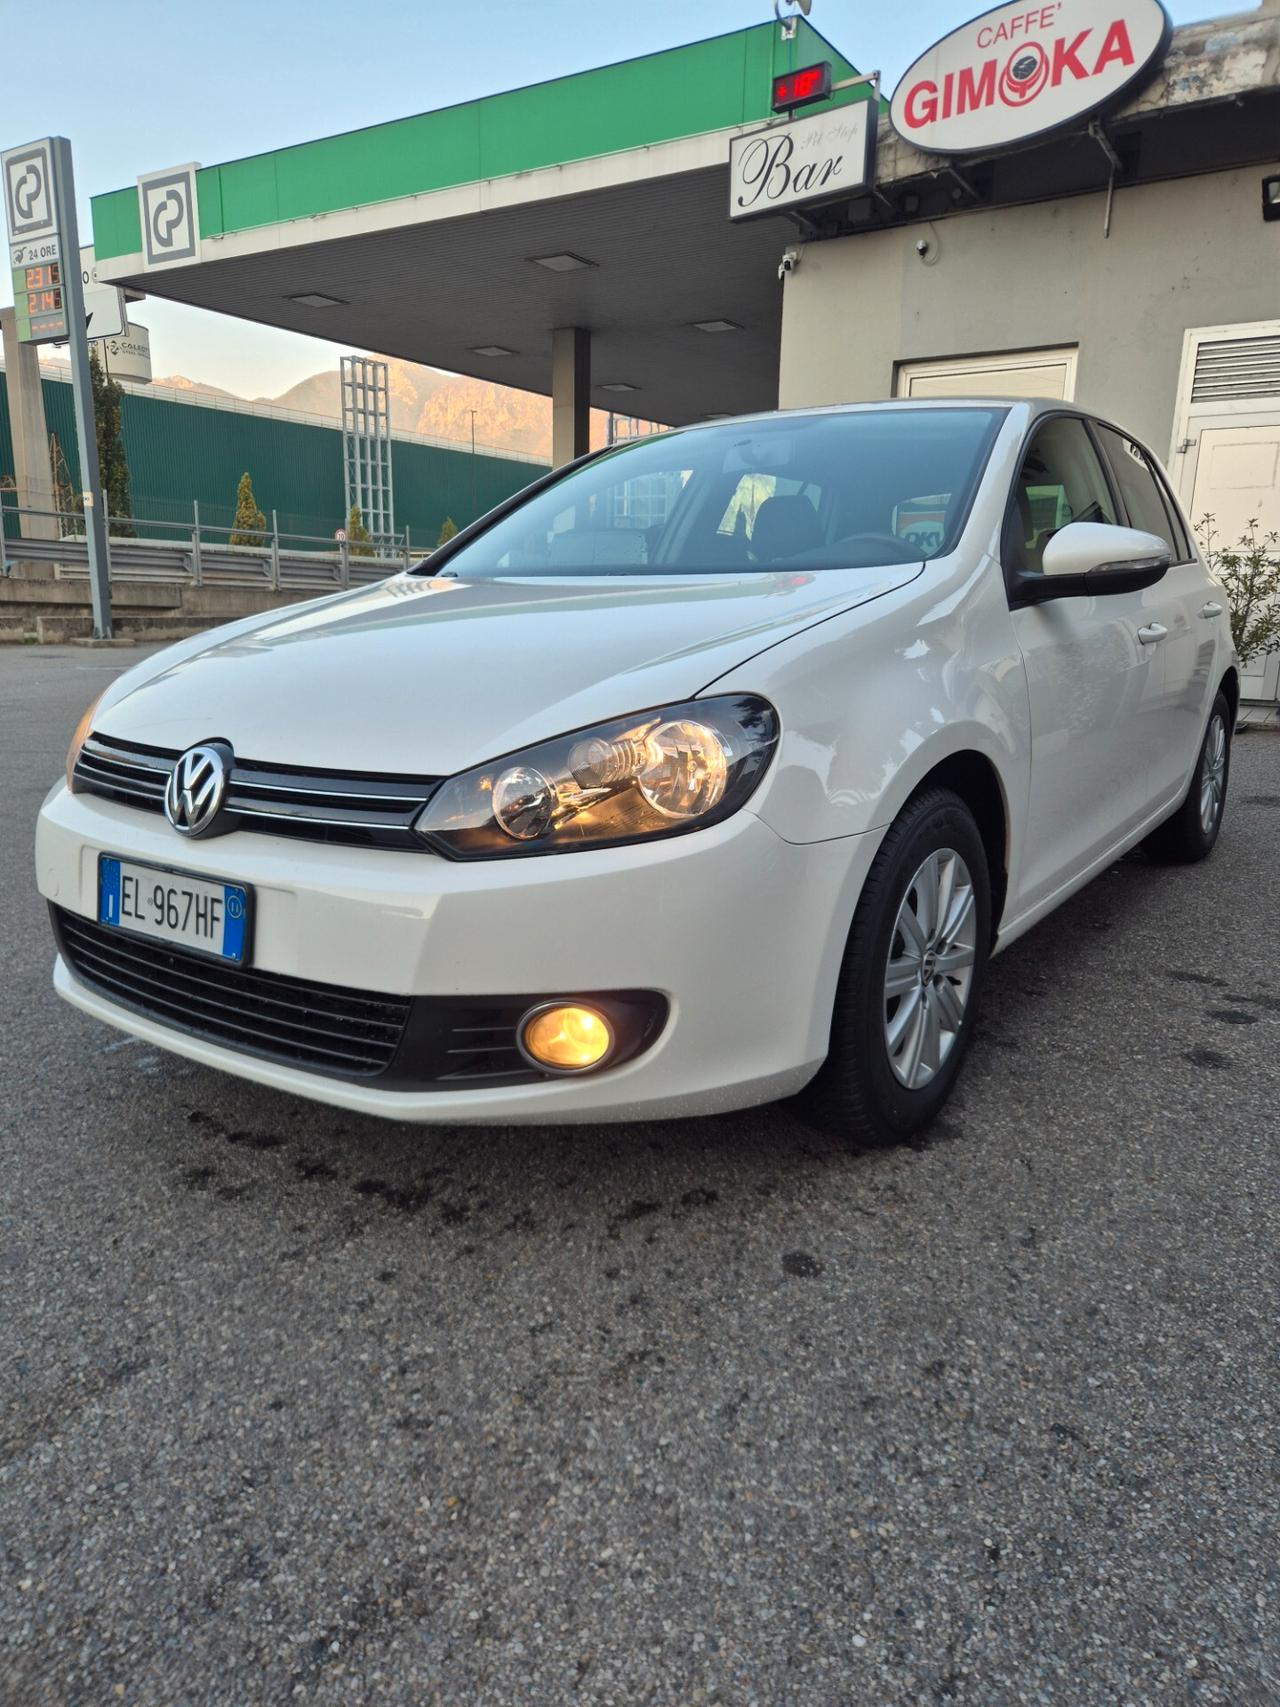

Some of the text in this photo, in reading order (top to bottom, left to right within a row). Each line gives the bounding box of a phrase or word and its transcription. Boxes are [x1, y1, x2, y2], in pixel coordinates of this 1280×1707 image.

[903, 18, 1136, 129] GIMOKA
[737, 132, 843, 208] Bar
[28, 244, 57, 261] 24 ORE
[121, 875, 224, 939] EL 967HF
